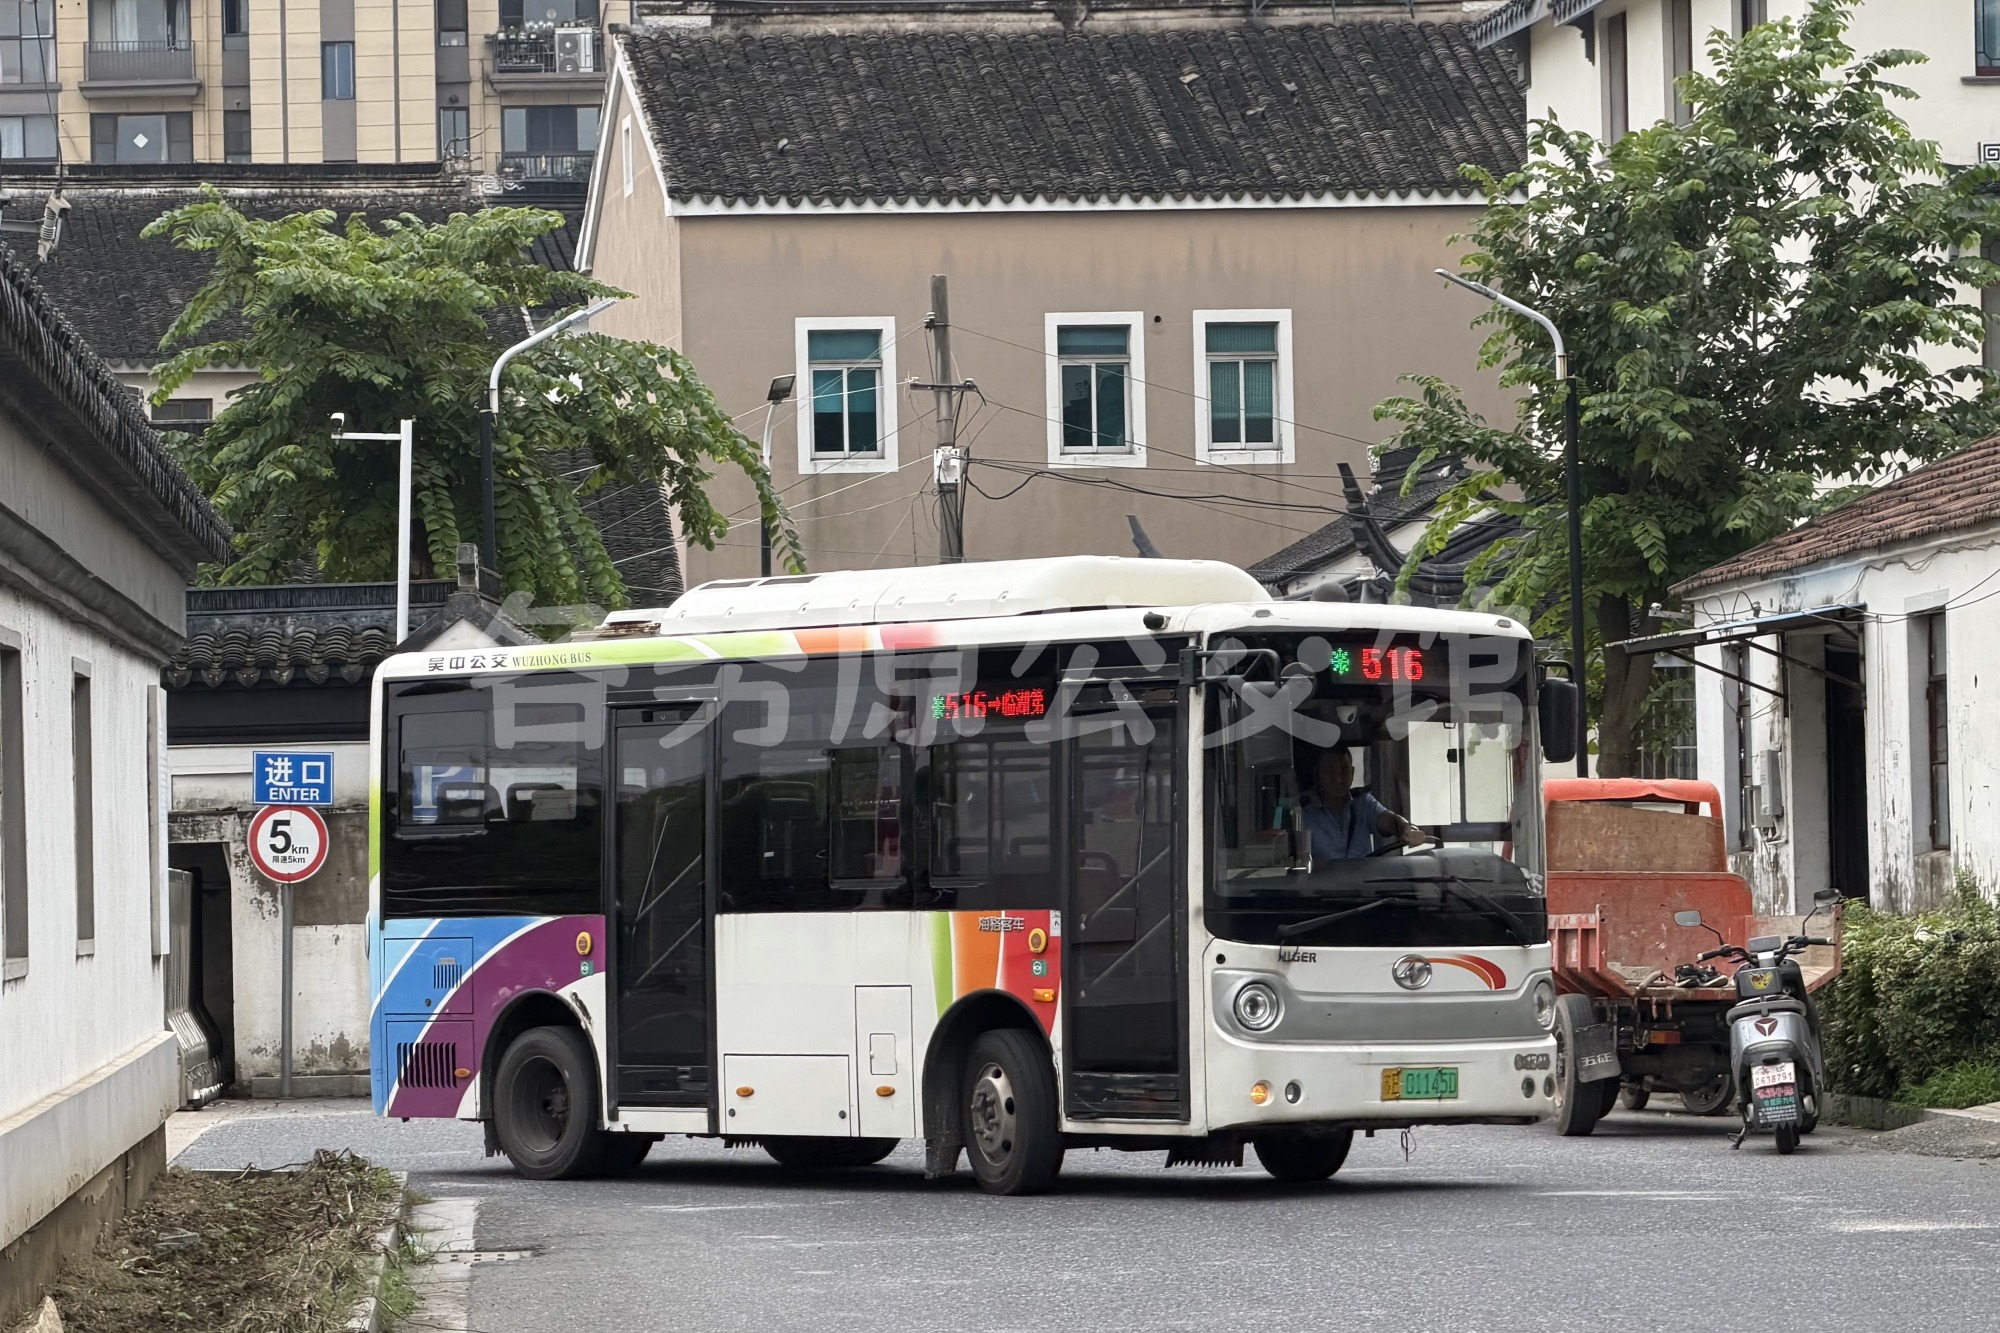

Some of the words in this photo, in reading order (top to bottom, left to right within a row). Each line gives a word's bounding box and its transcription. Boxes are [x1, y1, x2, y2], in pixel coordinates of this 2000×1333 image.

[428, 653, 508, 672] 吴中公交
[512, 653, 567, 668] WUZHONG
[570, 652, 592, 664] BUS
[1362, 648, 1423, 680] 516
[264, 756, 325, 787] 进口
[269, 787, 320, 801] ENTER
[978, 916, 1025, 932] 海格客车
[1755, 1071, 1793, 1087] 0638791
